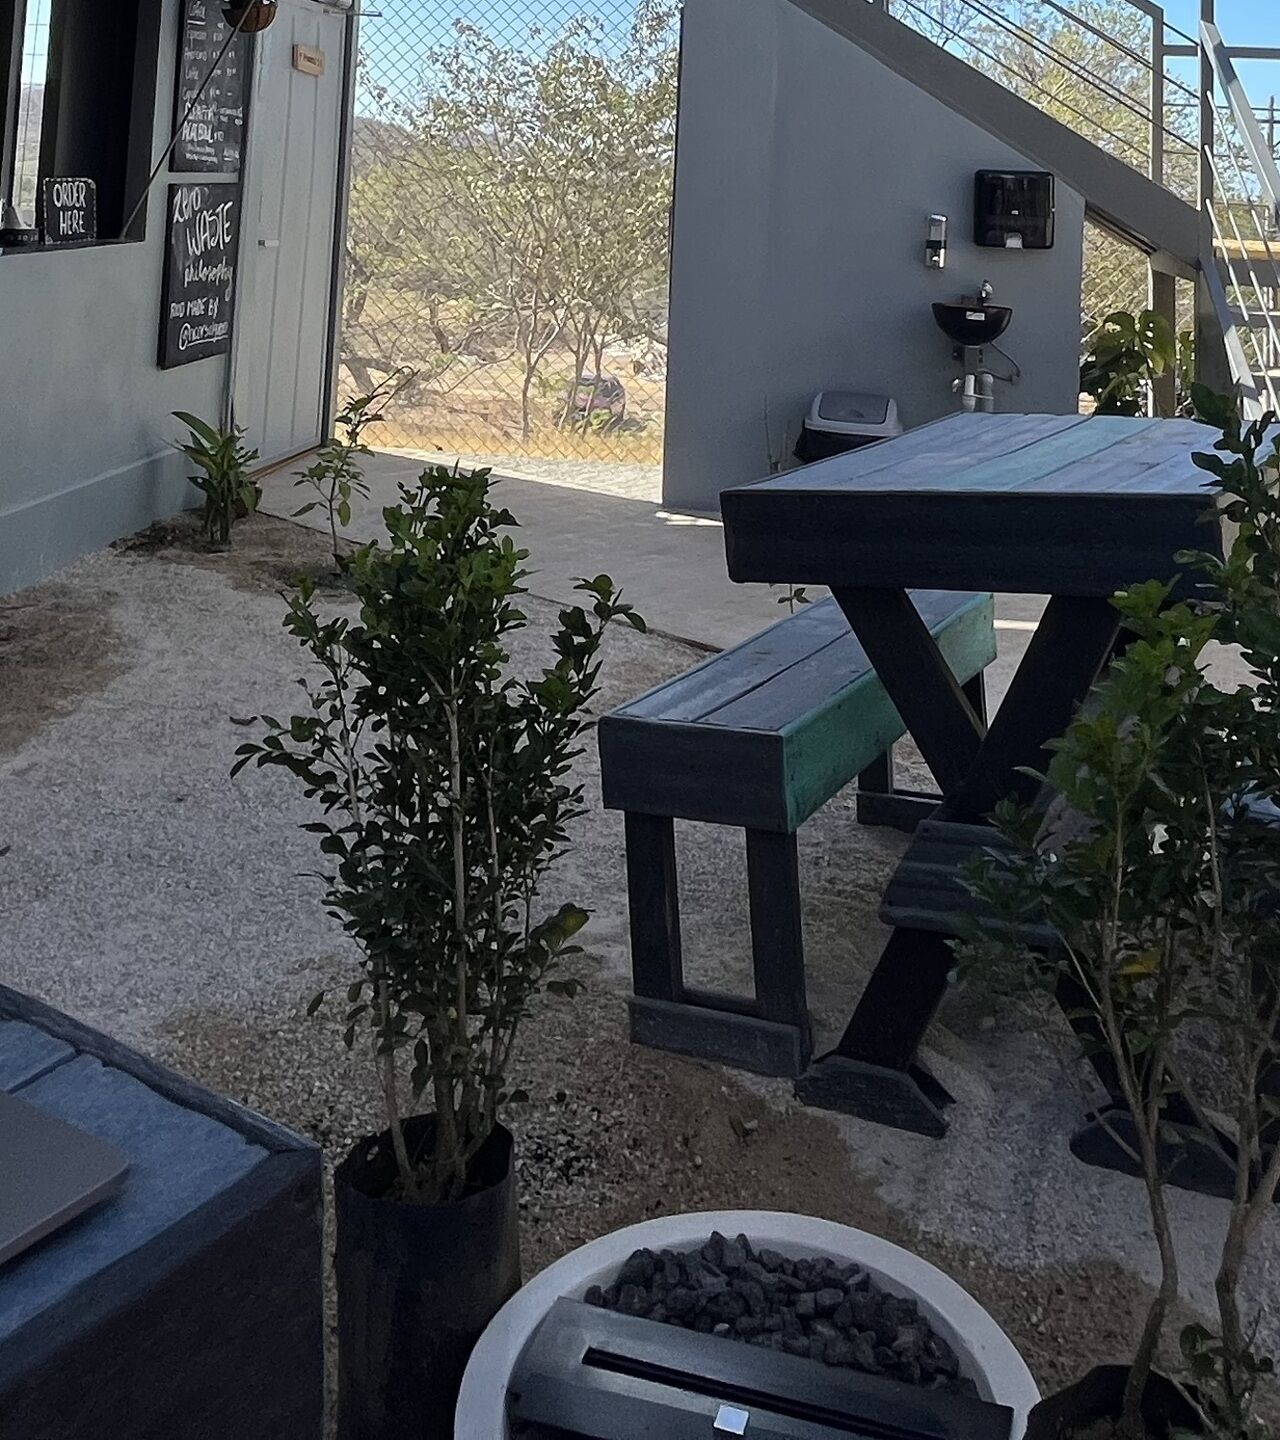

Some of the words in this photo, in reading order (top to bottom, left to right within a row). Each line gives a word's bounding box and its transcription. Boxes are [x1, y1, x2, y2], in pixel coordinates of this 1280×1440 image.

[53, 181, 87, 208] ORDER
[59, 209, 86, 236] HERE
[186, 201, 234, 257] WASTE
[183, 255, 234, 302] philosophy
